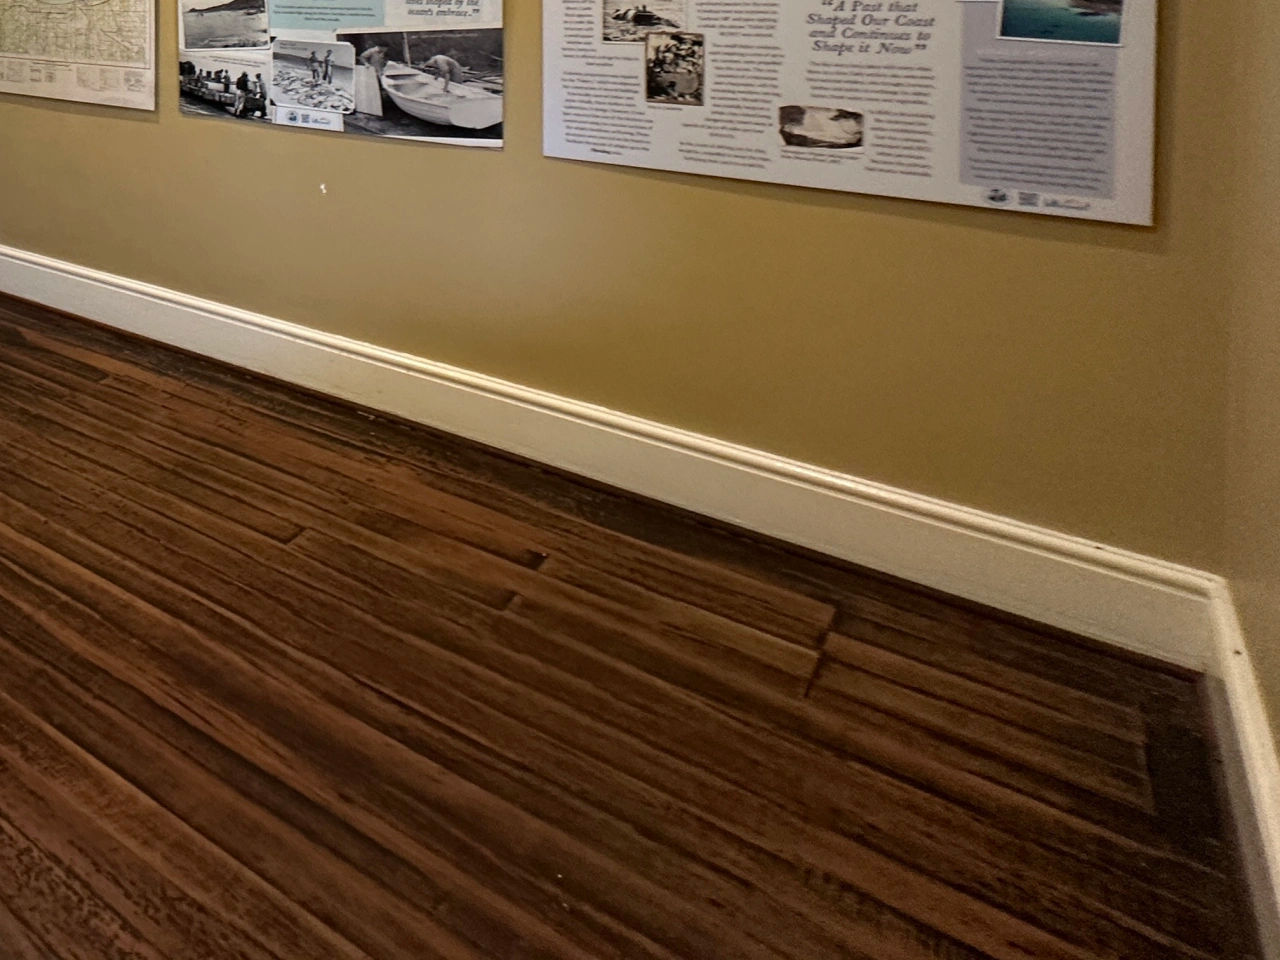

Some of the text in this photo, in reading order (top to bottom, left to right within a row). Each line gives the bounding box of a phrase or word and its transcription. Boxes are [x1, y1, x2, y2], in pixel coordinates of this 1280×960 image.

[851, 0, 883, 12] Past
[887, 0, 919, 12] that
[806, 13, 936, 29] Shaped Our Coast
[808, 26, 932, 41] and Continues to
[811, 40, 854, 56] Shape
[858, 41, 870, 53] it
